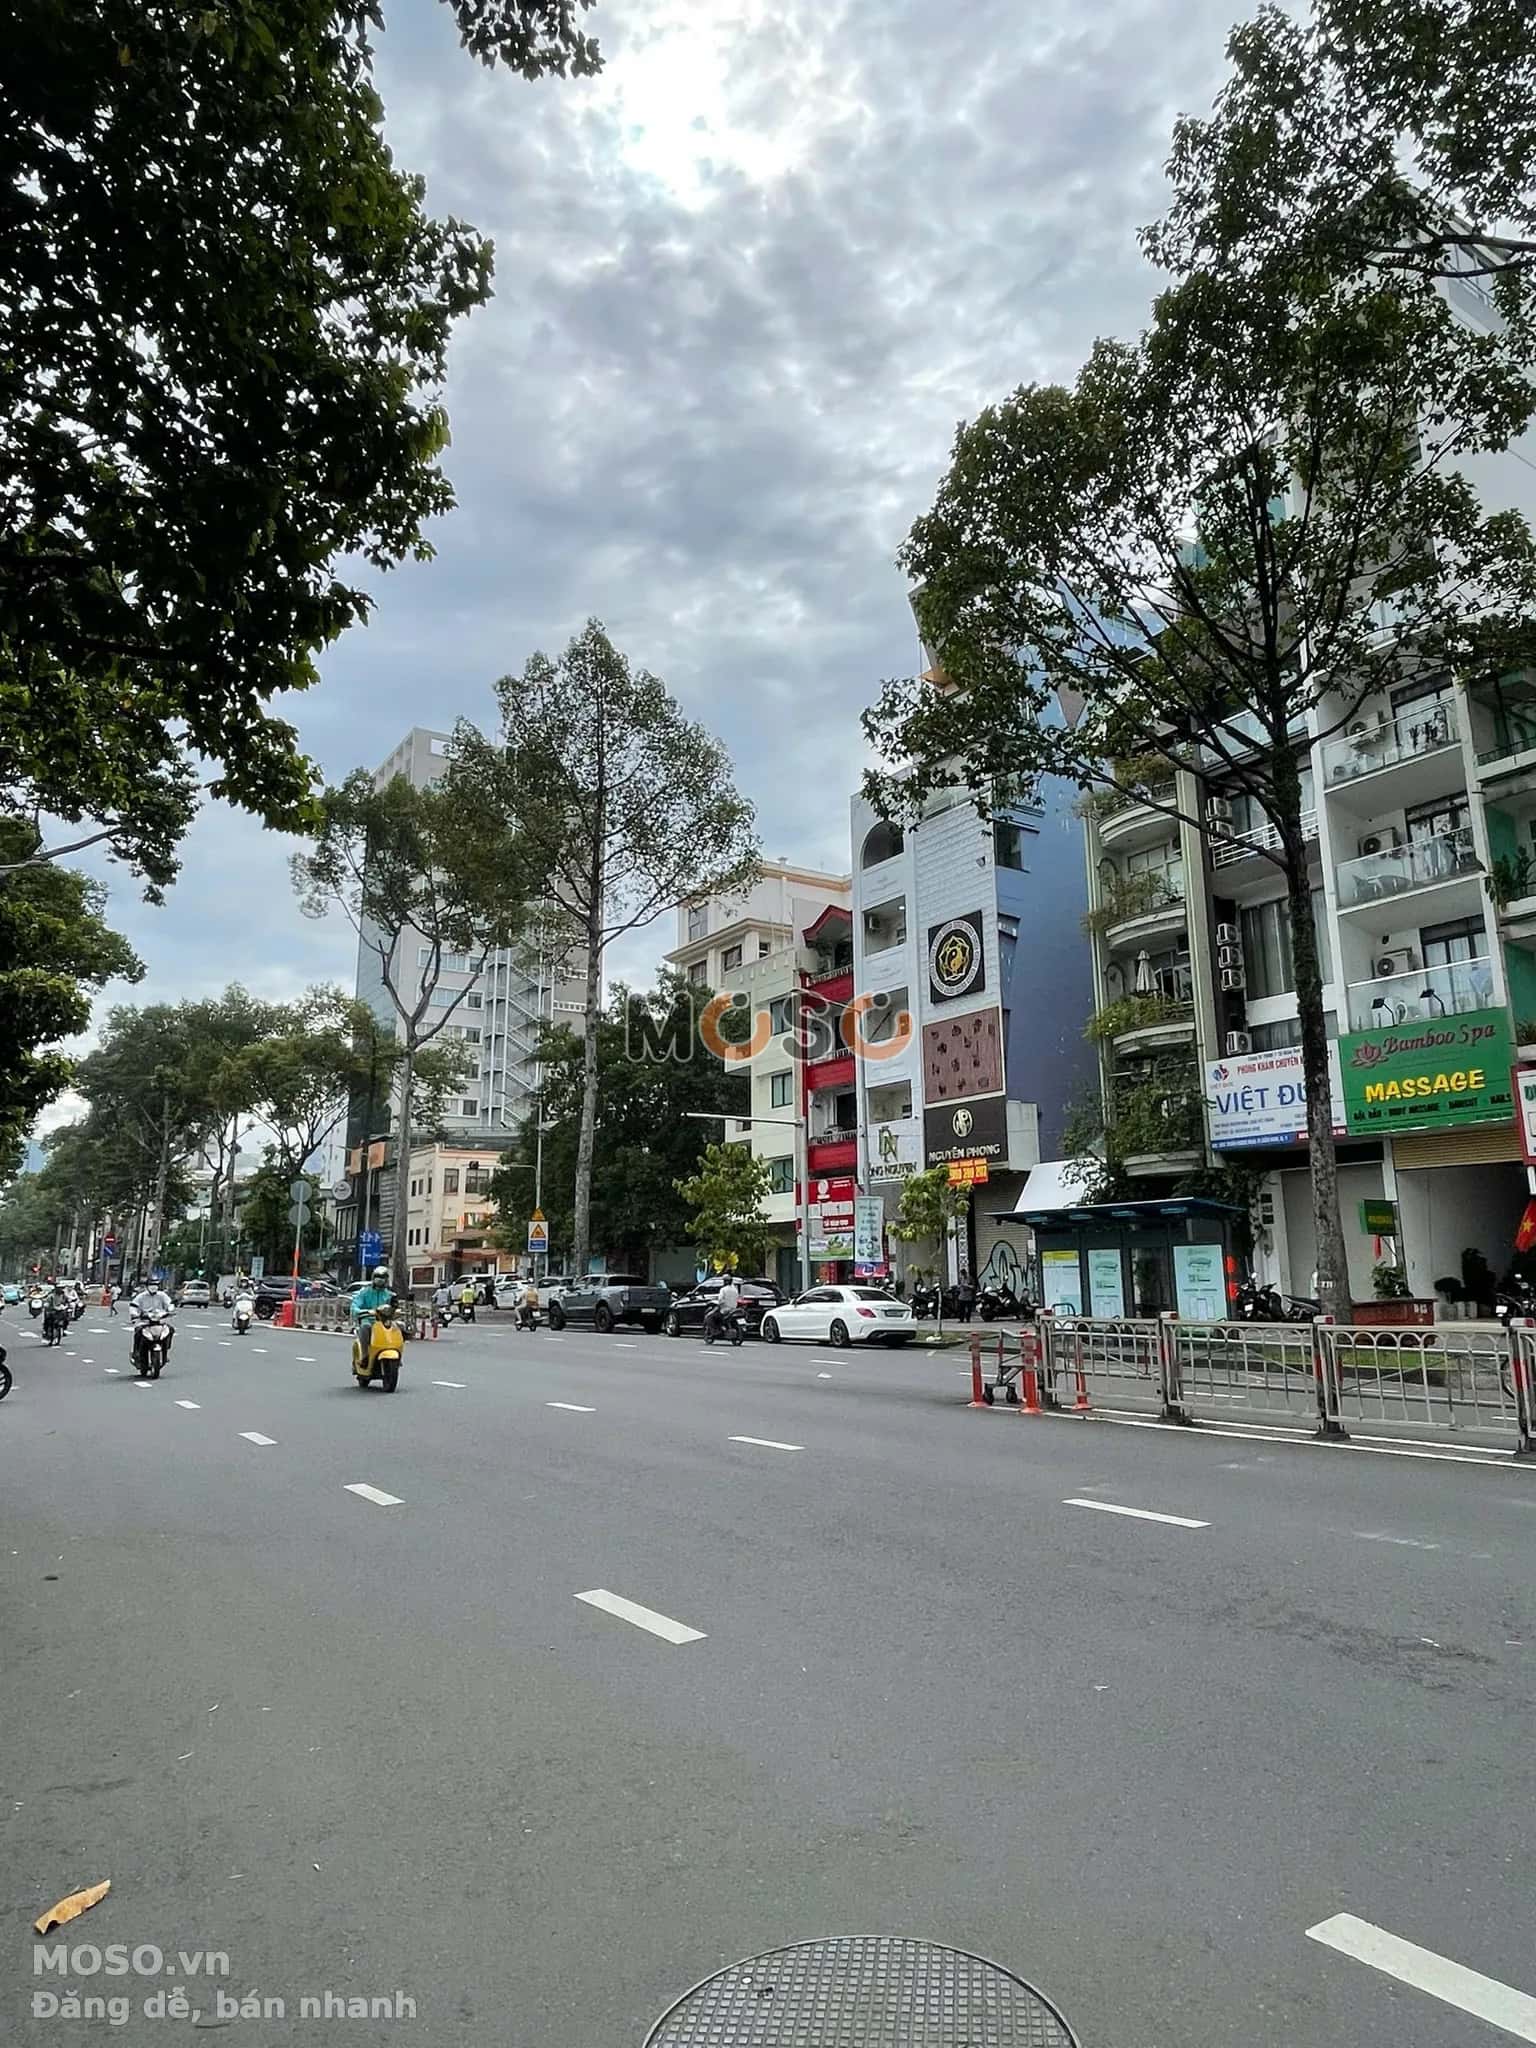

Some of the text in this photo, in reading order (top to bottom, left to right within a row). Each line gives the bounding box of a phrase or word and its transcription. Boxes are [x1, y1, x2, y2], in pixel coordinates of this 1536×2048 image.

[1383, 1023, 1497, 1055] Bamboo Spa
[1216, 1085, 1269, 1115] VIỆT
[1365, 1069, 1487, 1103] MASSAGE
[966, 1143, 1001, 1158] PHONG
